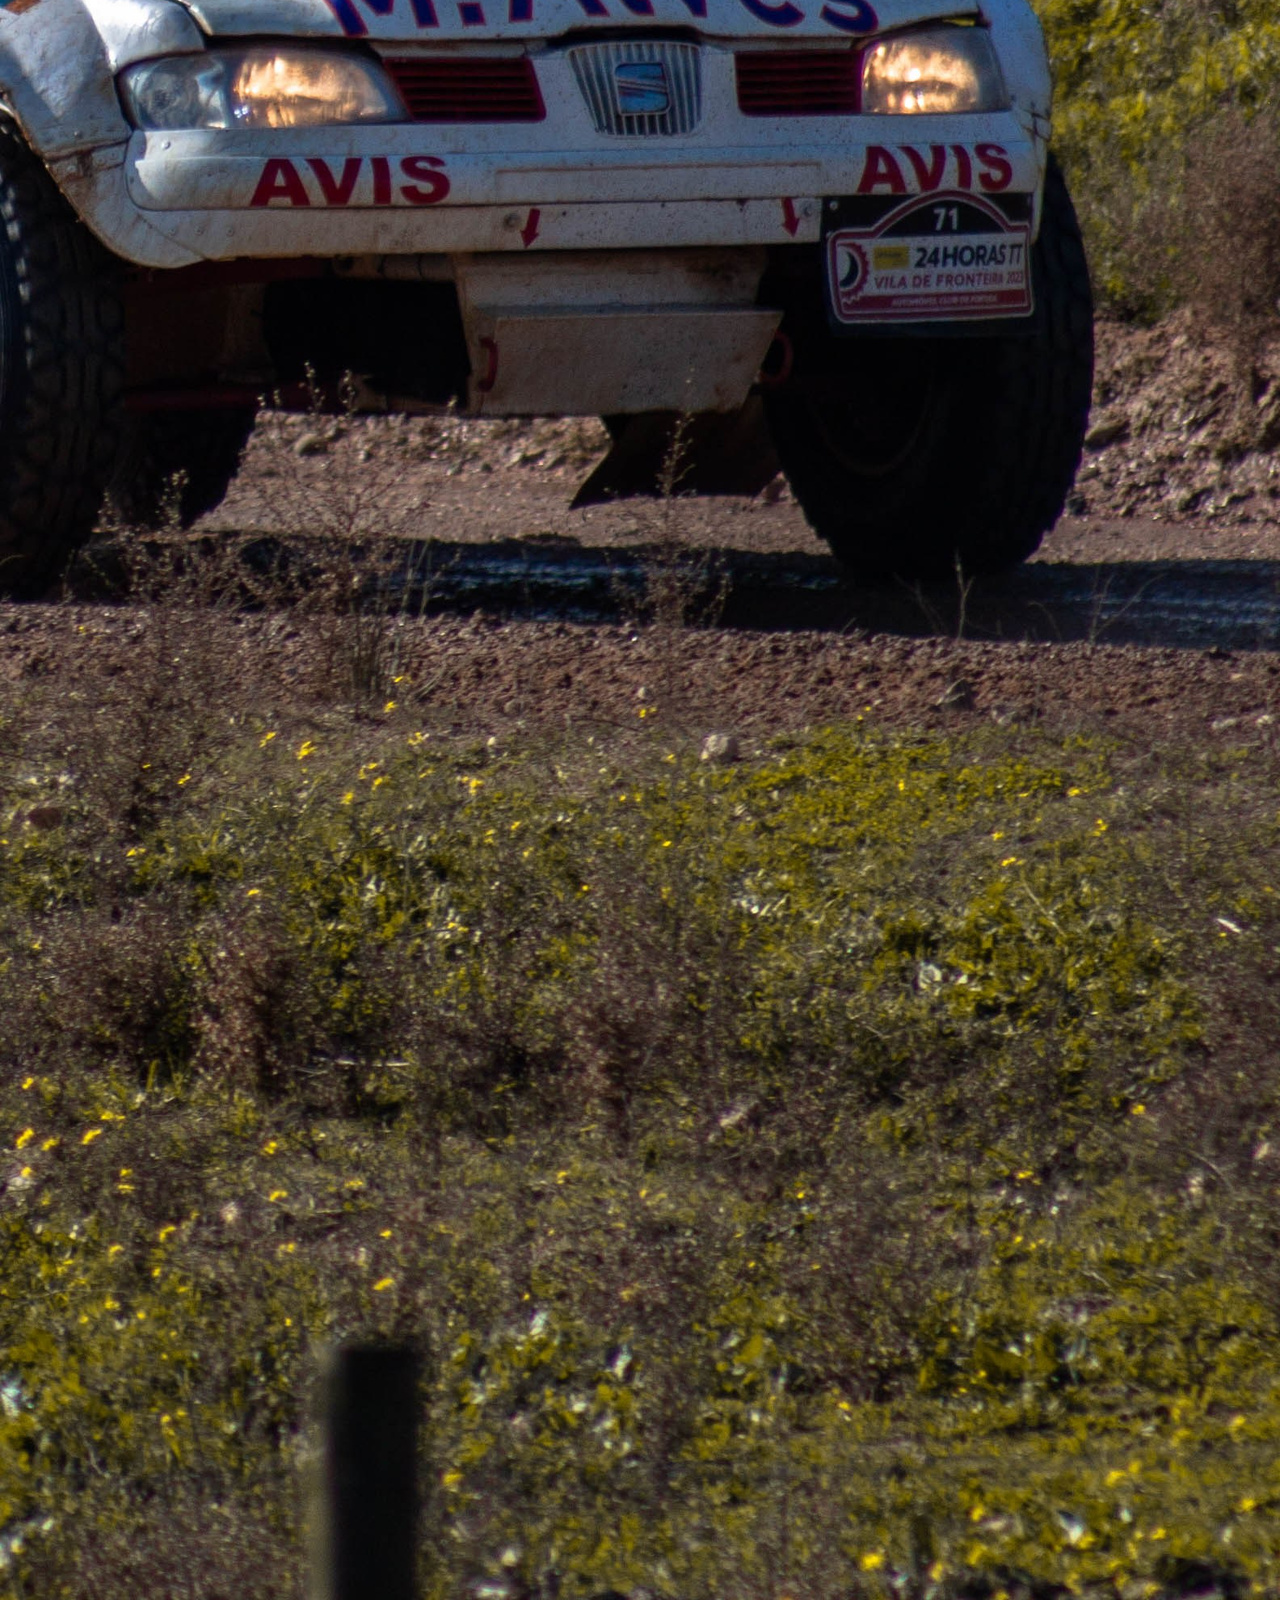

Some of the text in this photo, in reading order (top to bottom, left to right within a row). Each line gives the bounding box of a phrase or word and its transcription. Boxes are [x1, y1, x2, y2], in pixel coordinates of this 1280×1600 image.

[250, 154, 452, 208] AVIS
[856, 143, 1014, 195] AVIS
[933, 207, 959, 231] 71
[1008, 244, 1024, 265] TT
[874, 275, 908, 290] VILA
[911, 273, 932, 288] DE
[935, 270, 1004, 287] FRONTEIRA
